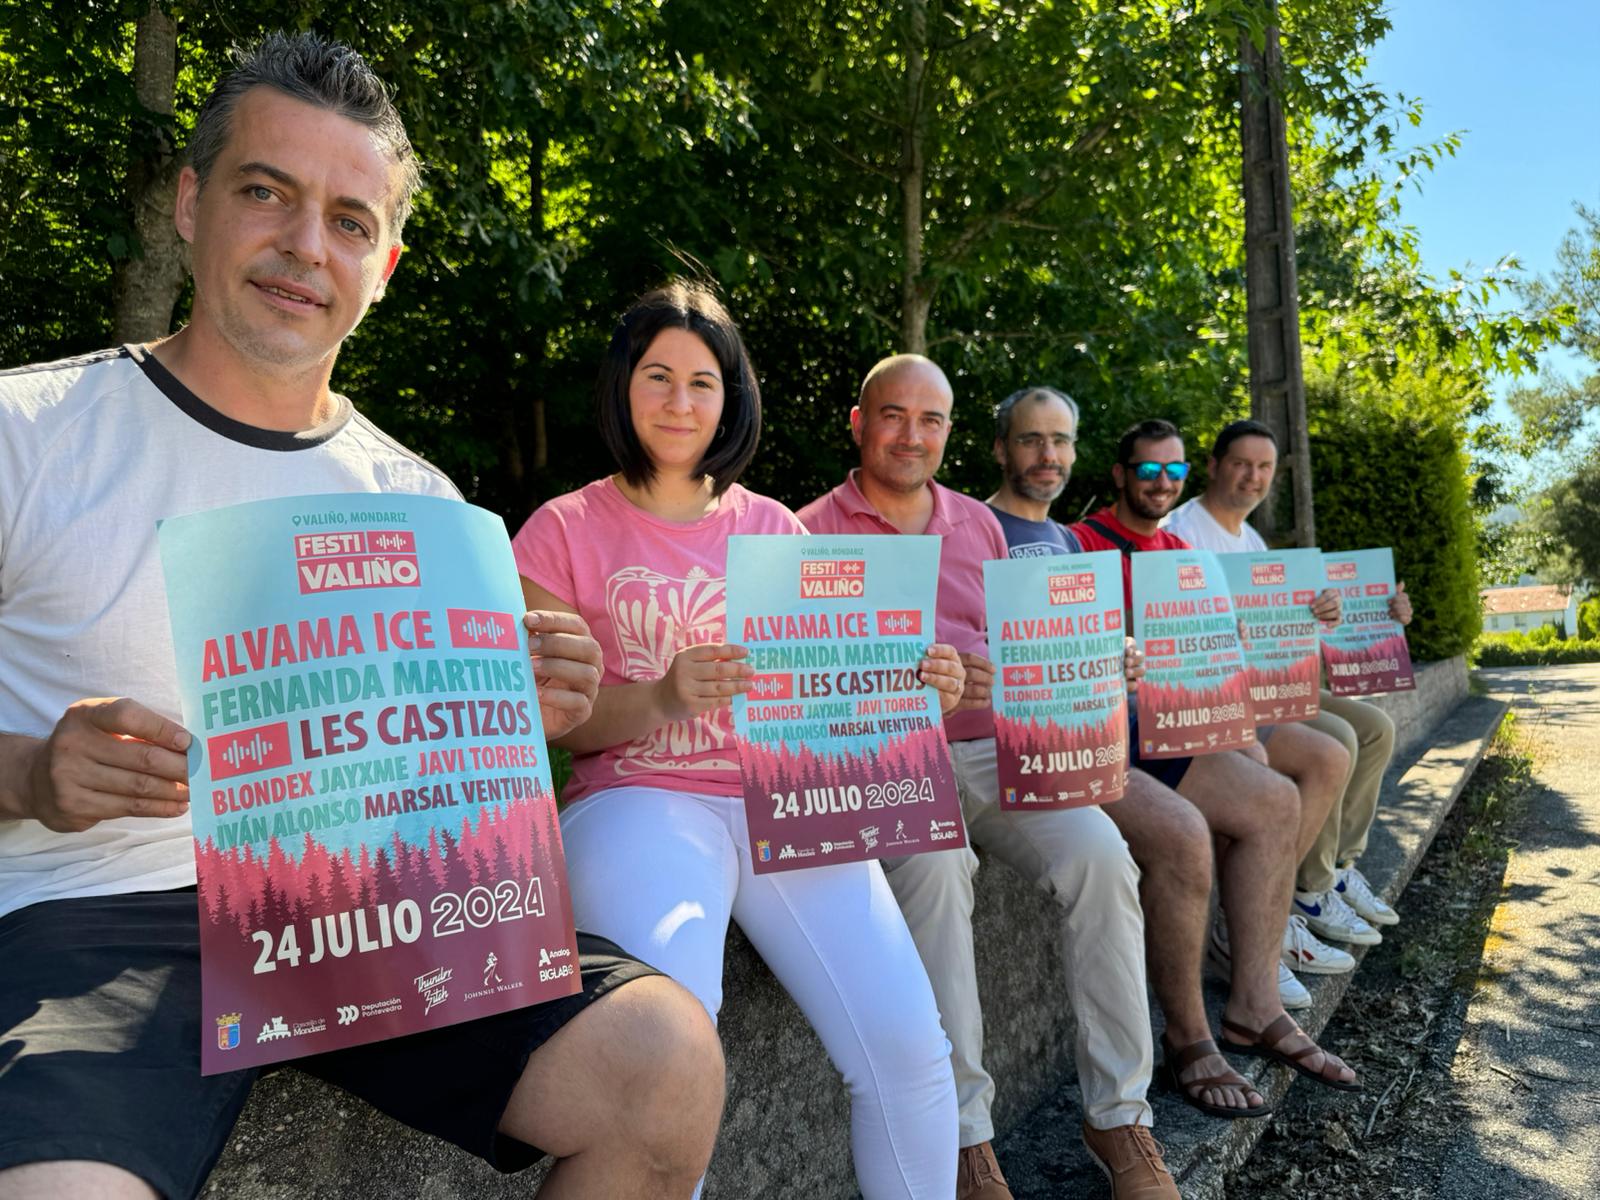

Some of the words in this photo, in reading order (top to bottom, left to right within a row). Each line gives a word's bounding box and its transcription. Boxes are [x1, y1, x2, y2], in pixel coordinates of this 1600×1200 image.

[303, 510, 349, 526] VALIÑO,
[350, 511, 408, 525] MONDARIZ
[299, 534, 360, 557] FESTI
[301, 556, 419, 590] VALIÑO
[803, 562, 835, 575] FESTI
[802, 577, 864, 597] VALIÑO
[1050, 576, 1076, 588] FESTI
[1050, 586, 1096, 603] VALIÑO
[1271, 592, 1288, 606] ICE
[1145, 600, 1196, 619] ALVAMA
[1198, 598, 1212, 614] ICE
[1346, 610, 1388, 624] CASTIZO
[743, 613, 832, 643] ALVAMA
[836, 612, 869, 638] ICE
[1001, 617, 1075, 642] ALVAMA
[1079, 614, 1100, 635] ICE
[1249, 625, 1268, 640] LES
[202, 614, 365, 683] ALVAMA
[374, 610, 436, 652] ICE
[845, 642, 924, 667] MARTINS
[1000, 641, 1082, 663] FERNANDA
[1179, 637, 1197, 654] LES
[800, 672, 832, 698] LES
[1048, 663, 1075, 684] LES
[203, 662, 386, 730] FERNANDA
[394, 659, 526, 696] MARTINS
[1004, 689, 1053, 703] BLONDEX
[1073, 698, 1106, 713] MARSAL
[747, 705, 804, 723] BLONDEX
[806, 702, 853, 720] JAYXME
[856, 700, 882, 717] JAVI
[884, 696, 929, 714] TORRES
[1156, 712, 1175, 729] 24
[1177, 707, 1210, 728] JULIO
[1212, 702, 1245, 723] 2024
[300, 710, 369, 760] LES
[377, 699, 533, 746] CASTIZOS
[749, 723, 779, 743] IVÁN
[782, 724, 828, 741] ALONSO
[829, 720, 878, 738] MARSAL
[878, 716, 933, 733] VENTURA
[1020, 755, 1043, 774] 24
[1047, 749, 1094, 774] JULIO
[211, 770, 315, 817] BLONDEX
[319, 755, 409, 796] JAYXME
[417, 749, 466, 778] JAVI
[469, 744, 538, 770] TORRES
[771, 792, 800, 819] 24
[804, 785, 863, 817] JULIO
[865, 777, 936, 810] 2024
[215, 806, 269, 851] IVÁN
[271, 799, 362, 842] ALONSO
[364, 783, 458, 820] MARSAL
[461, 776, 544, 806] VENTURA
[251, 924, 301, 975] 24
[309, 898, 423, 964] JULIO
[430, 876, 546, 938] 2024
[361, 997, 402, 1012] Deputación
[362, 1004, 403, 1018] Pontevedra
